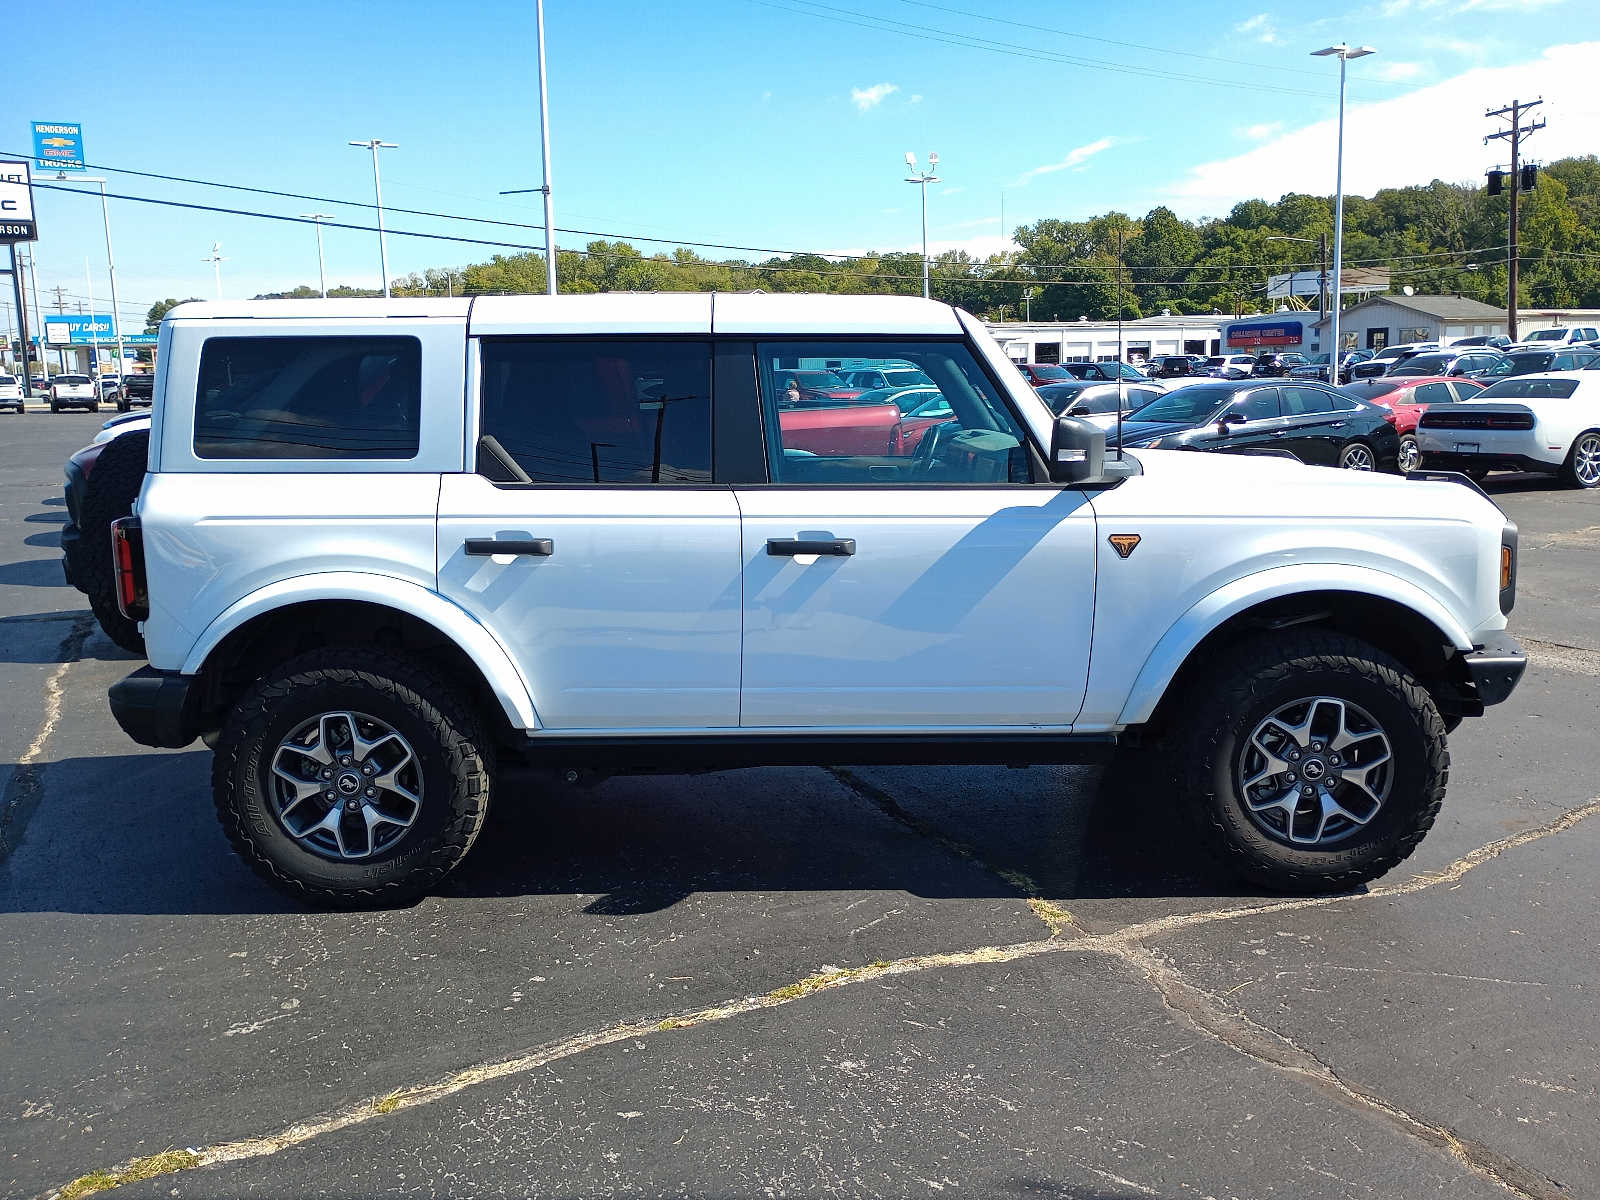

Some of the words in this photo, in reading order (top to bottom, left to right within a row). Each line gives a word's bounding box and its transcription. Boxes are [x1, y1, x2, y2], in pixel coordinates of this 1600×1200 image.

[36, 125, 78, 134] HENDERSON
[44, 149, 76, 157] GMC
[39, 160, 82, 168] TRUCKS
